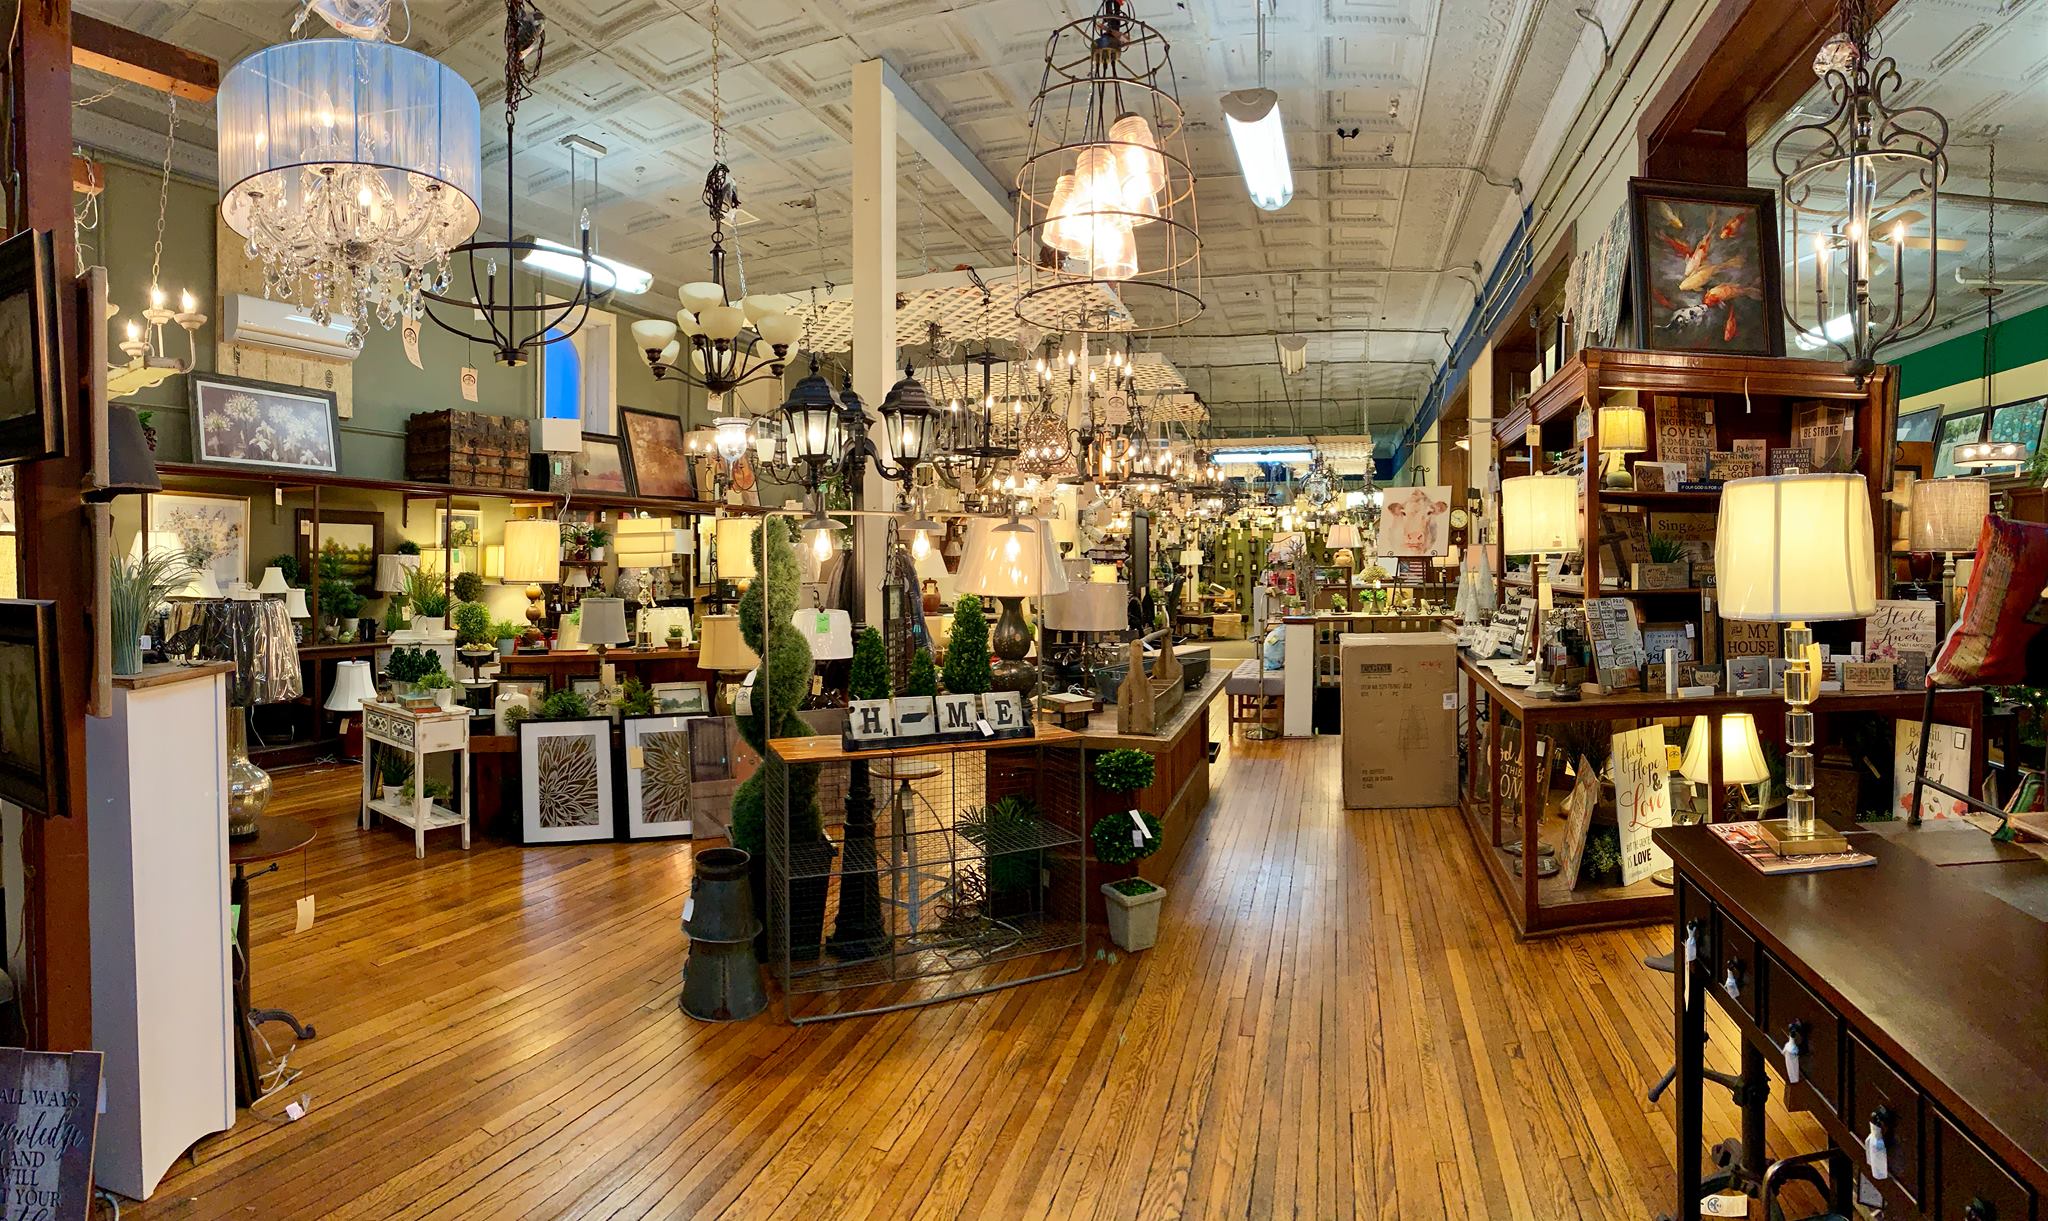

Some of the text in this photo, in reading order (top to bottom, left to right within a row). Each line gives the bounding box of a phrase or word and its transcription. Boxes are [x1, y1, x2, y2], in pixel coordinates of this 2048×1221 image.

[1660, 427, 1712, 439] LOVELY
[1804, 425, 1839, 438] BE STRONG
[1661, 438, 1713, 448] ADMIRABLE
[1661, 447, 1714, 456] EXCELLENT
[1728, 464, 1750, 472] LOVE
[1731, 471, 1750, 479] GOD
[1658, 519, 1687, 534] Sing
[1747, 624, 1771, 639] MY
[1879, 627, 1926, 646] Know
[1727, 640, 1776, 654] HOUSE
[1845, 667, 1891, 681] PRAY
[1652, 772, 1663, 792] &
[1620, 783, 1666, 830] Love
[1633, 848, 1652, 867] LOVE
[0, 1088, 80, 1109] ALL WAYS
[11, 1150, 46, 1169] AND
[0, 1167, 40, 1187] WILL
[15, 1188, 62, 1208] YOUR
